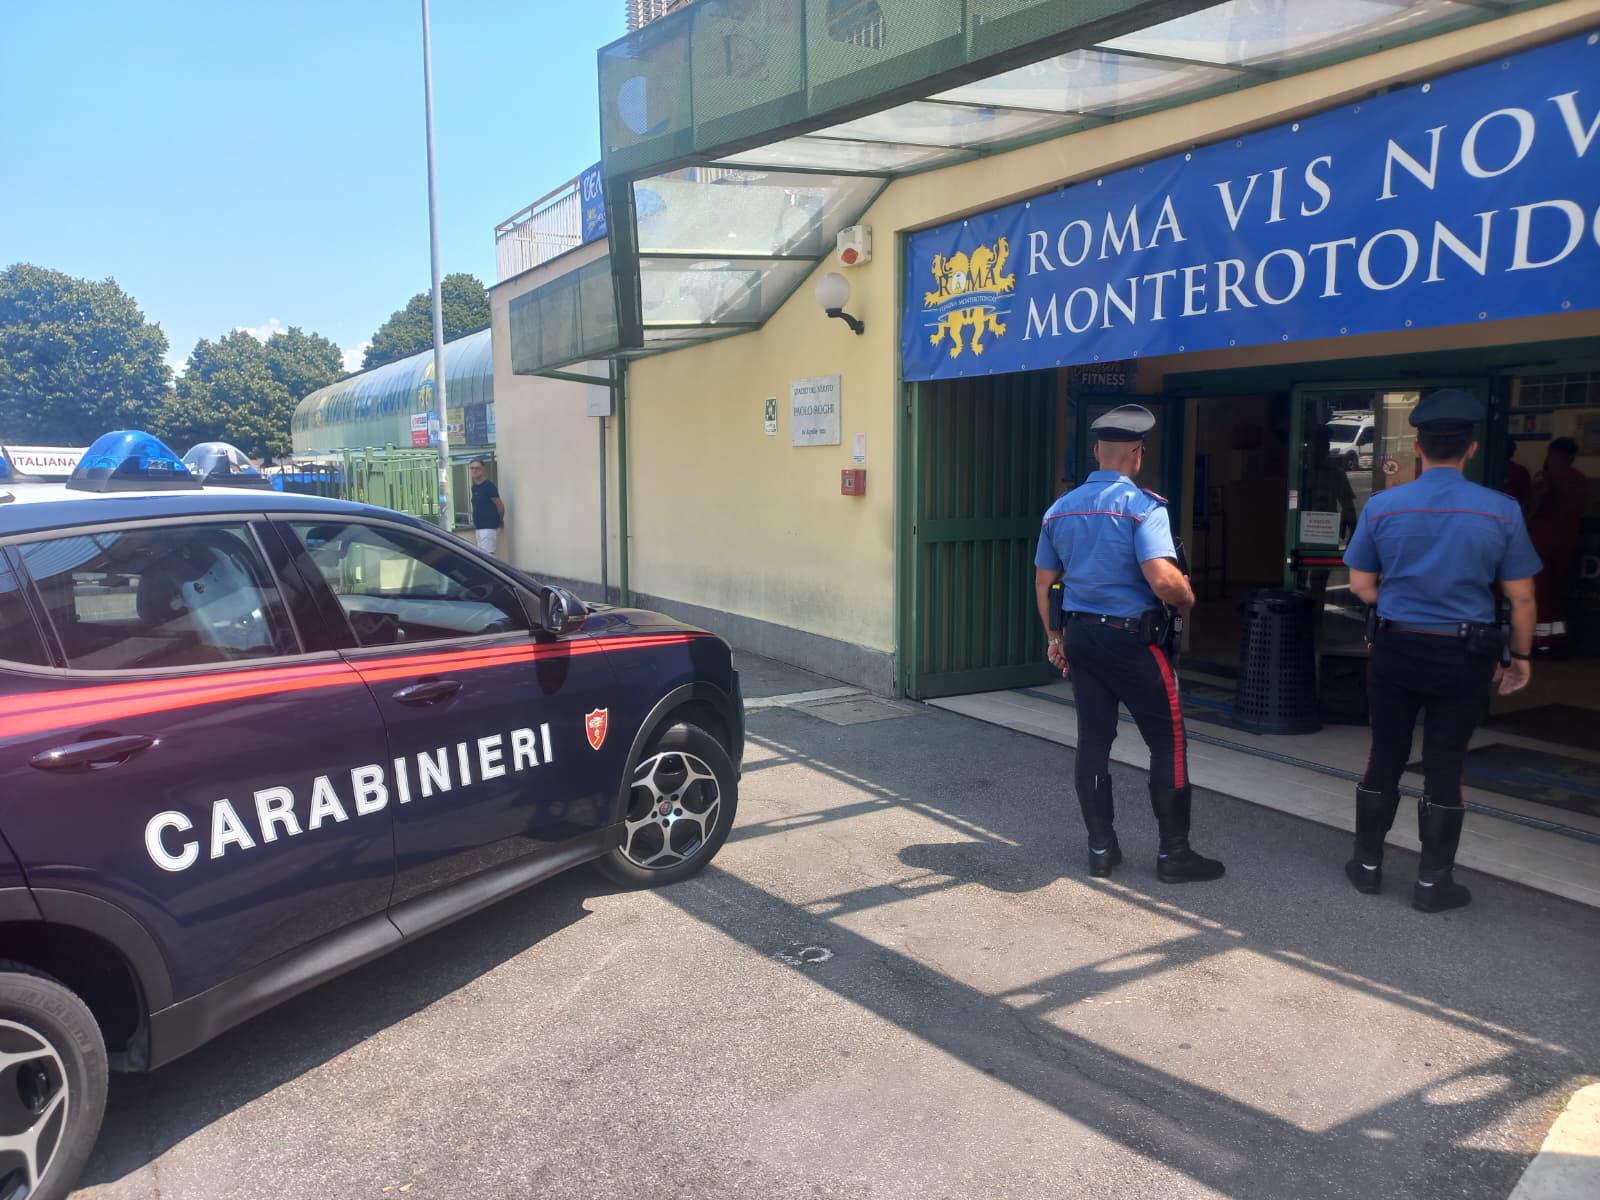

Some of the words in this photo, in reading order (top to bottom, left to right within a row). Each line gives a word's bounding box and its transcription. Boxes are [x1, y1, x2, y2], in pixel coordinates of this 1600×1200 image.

[1022, 199, 1600, 341] MONTEROTOND
[1028, 194, 1187, 276] ROMA
[1213, 155, 1332, 232] VIS
[1081, 373, 1126, 386] FITNESS
[13, 456, 76, 467] ITALIANA
[143, 721, 554, 873] CARABINIERI
